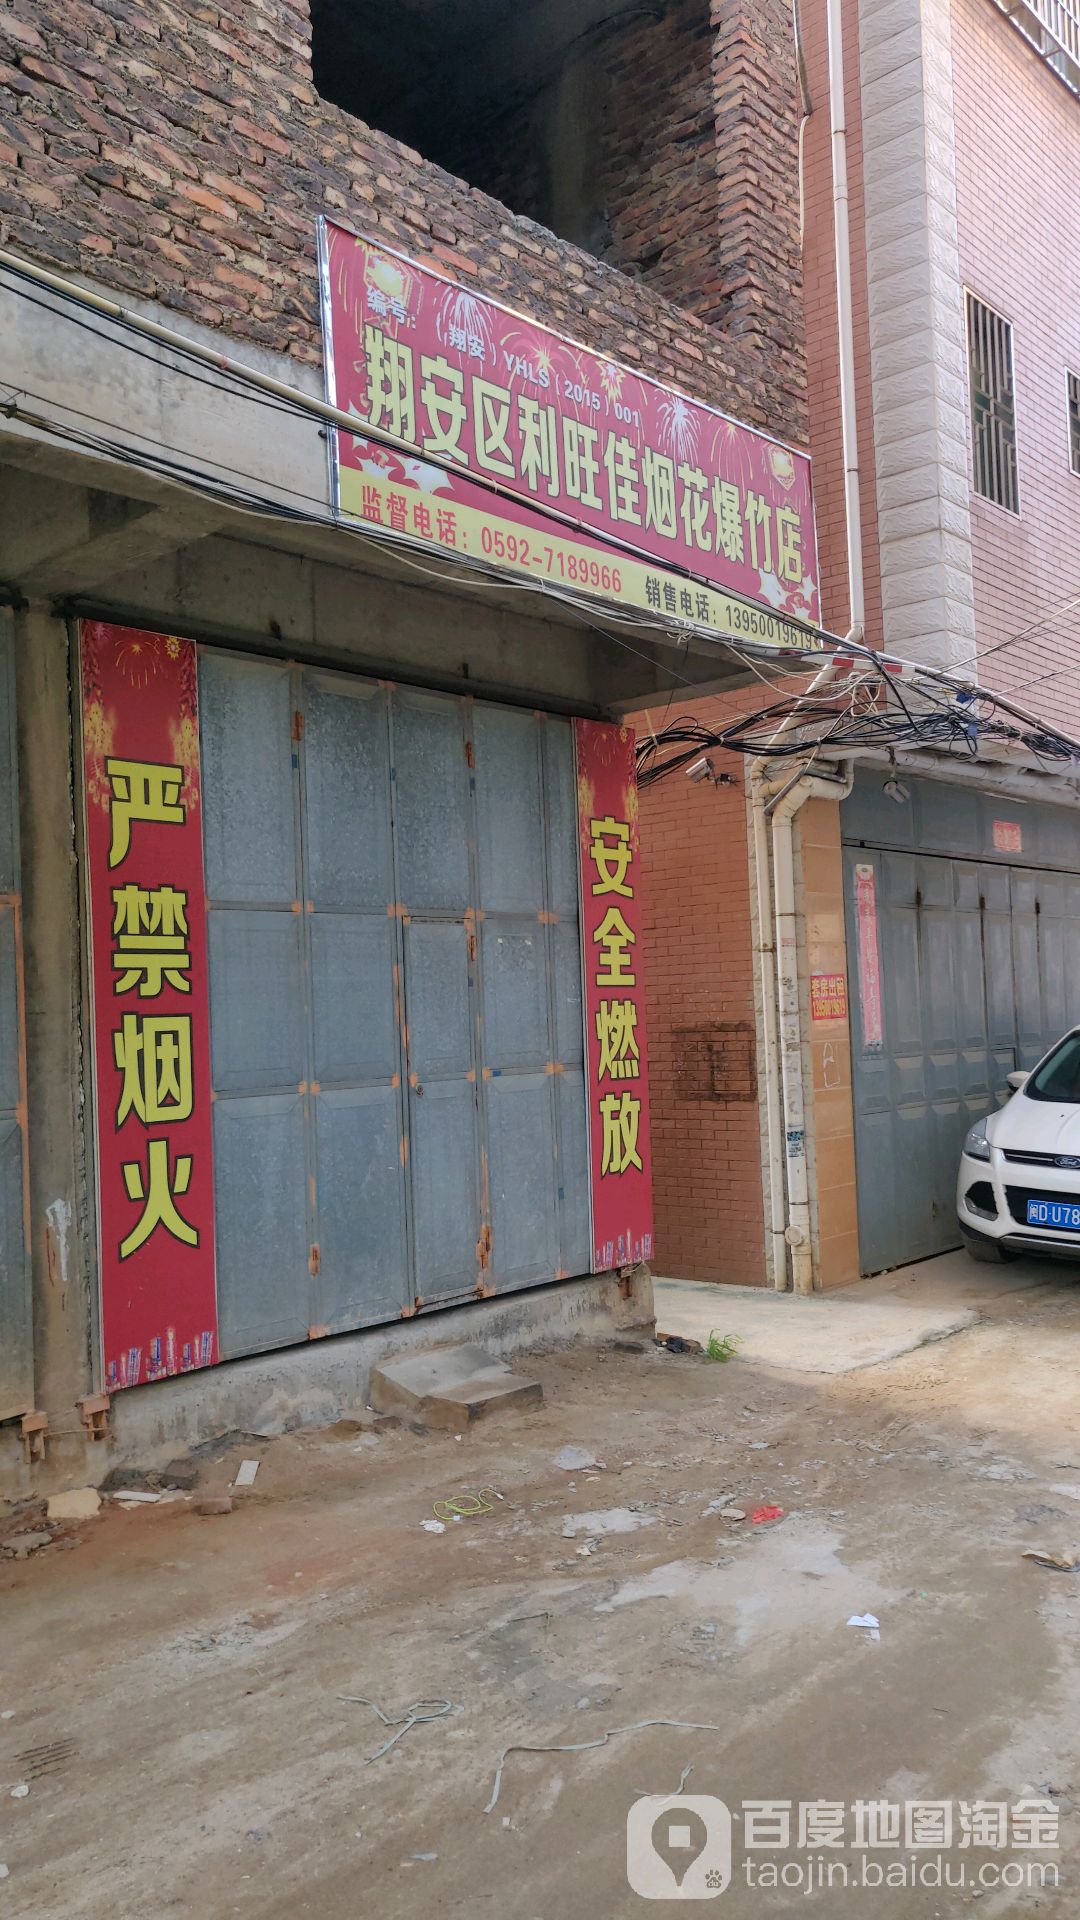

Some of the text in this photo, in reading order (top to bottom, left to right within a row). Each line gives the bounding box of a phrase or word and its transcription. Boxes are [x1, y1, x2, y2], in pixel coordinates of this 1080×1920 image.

[363, 325, 803, 584] 翔安区利旺佳烟花爆竹店
[107, 755, 199, 1262] 严禁烟火
[589, 814, 644, 1178] 安全燃放
